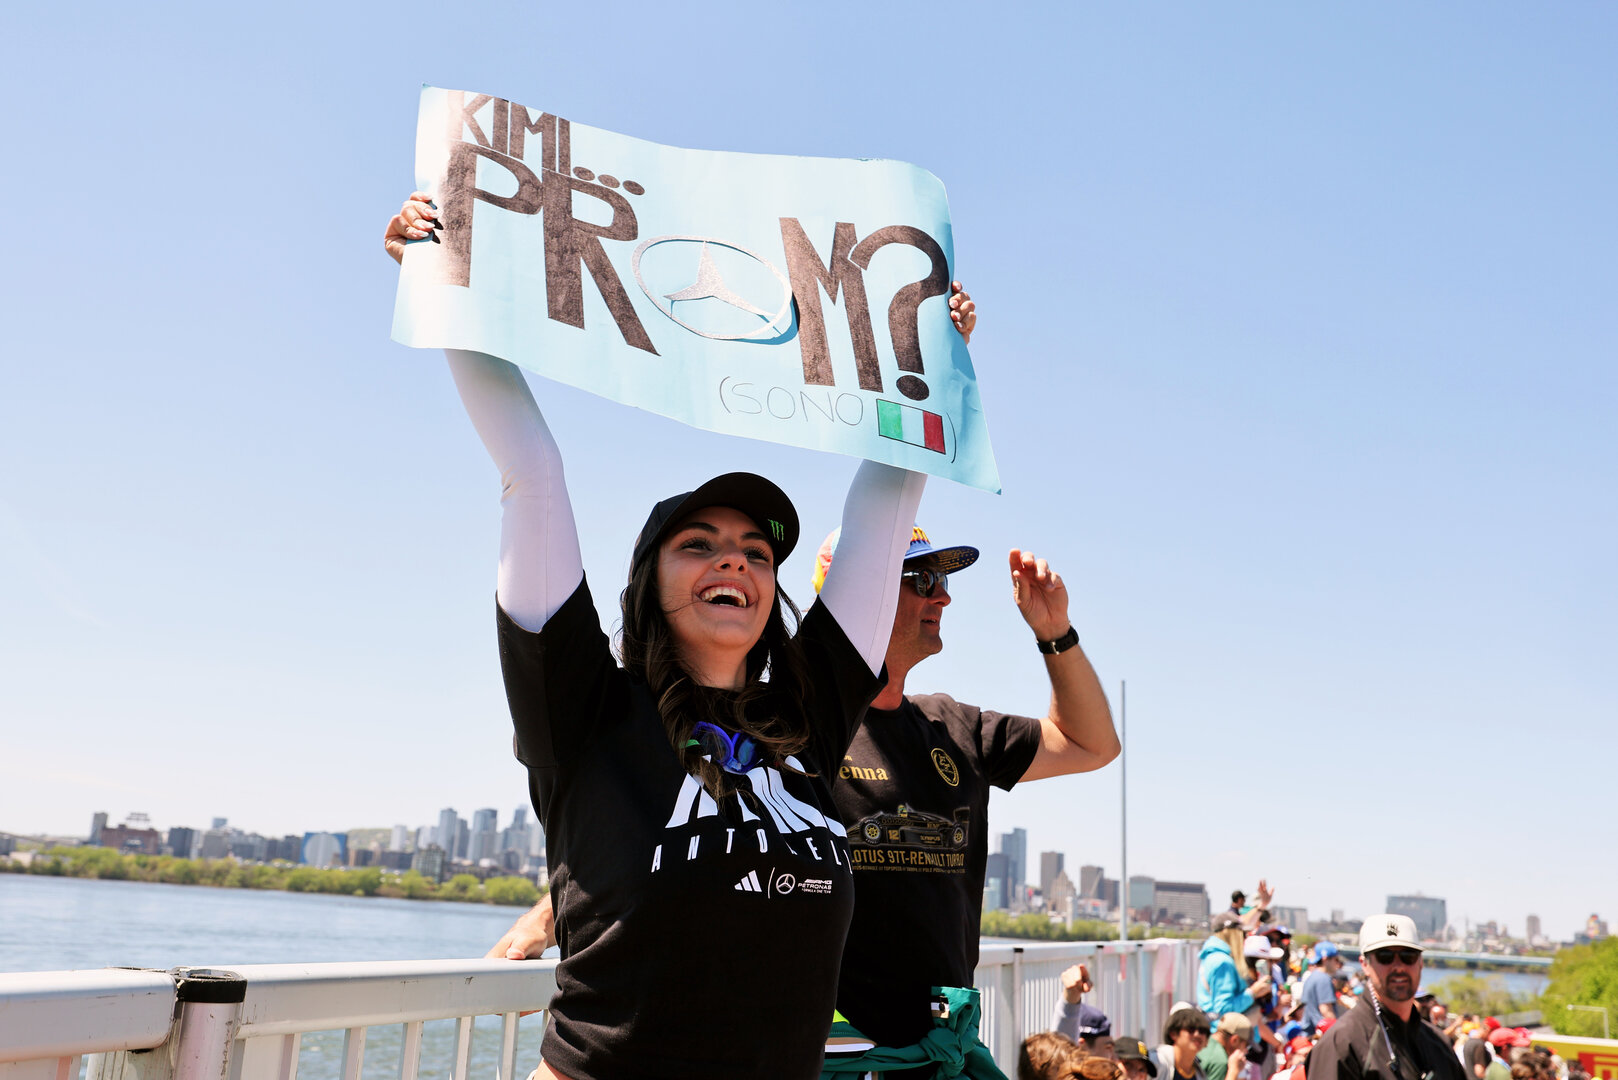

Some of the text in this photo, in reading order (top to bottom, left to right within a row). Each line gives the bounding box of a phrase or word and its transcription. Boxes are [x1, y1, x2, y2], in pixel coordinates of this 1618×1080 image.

[719, 376, 863, 426] (SONO
[839, 765, 889, 781] enna
[888, 829, 899, 841] 12
